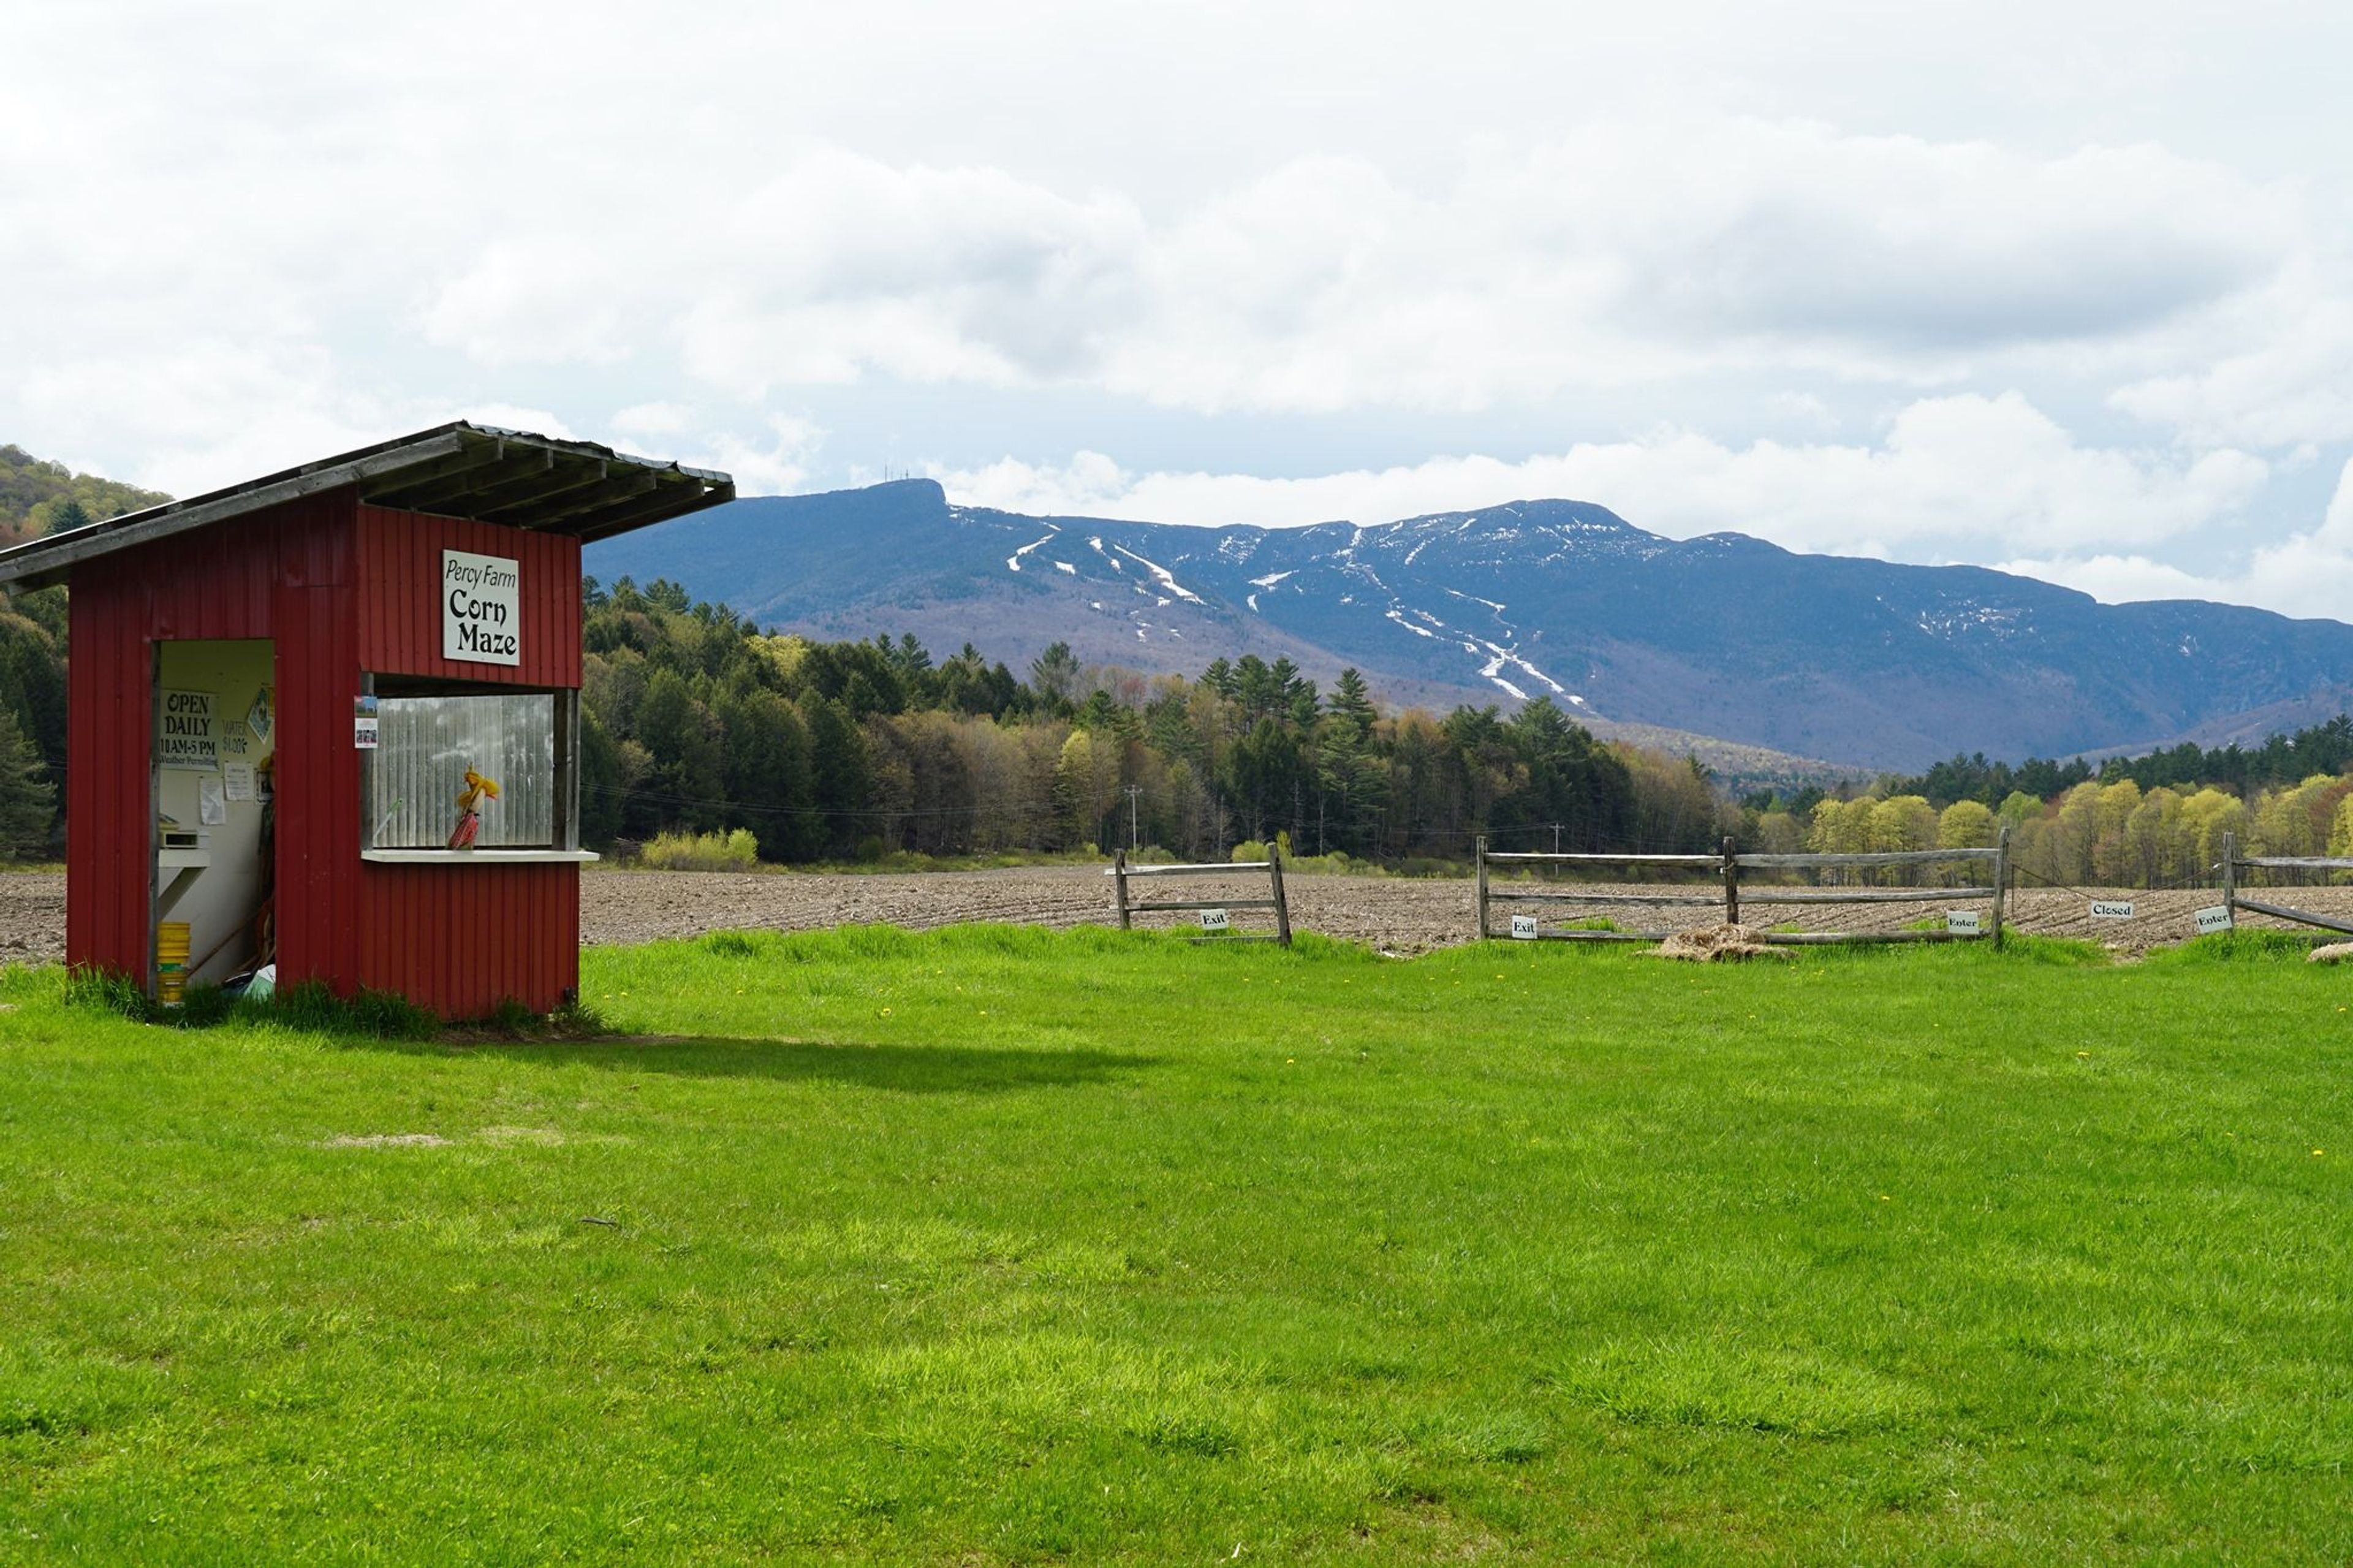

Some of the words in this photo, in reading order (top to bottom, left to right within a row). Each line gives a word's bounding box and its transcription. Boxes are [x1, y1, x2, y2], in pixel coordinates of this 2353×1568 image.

[446, 559, 482, 589] Percy
[483, 565, 516, 588] Farm
[450, 589, 506, 628] Corn
[458, 623, 517, 656] Maze
[168, 693, 209, 714] OPEN
[165, 716, 210, 737] DAILY
[2093, 904, 2131, 915] Closed
[1203, 914, 1225, 924] Exit
[1514, 921, 1534, 933] Exit
[1949, 918, 1977, 927] Enter
[2198, 915, 2227, 925] Enter
